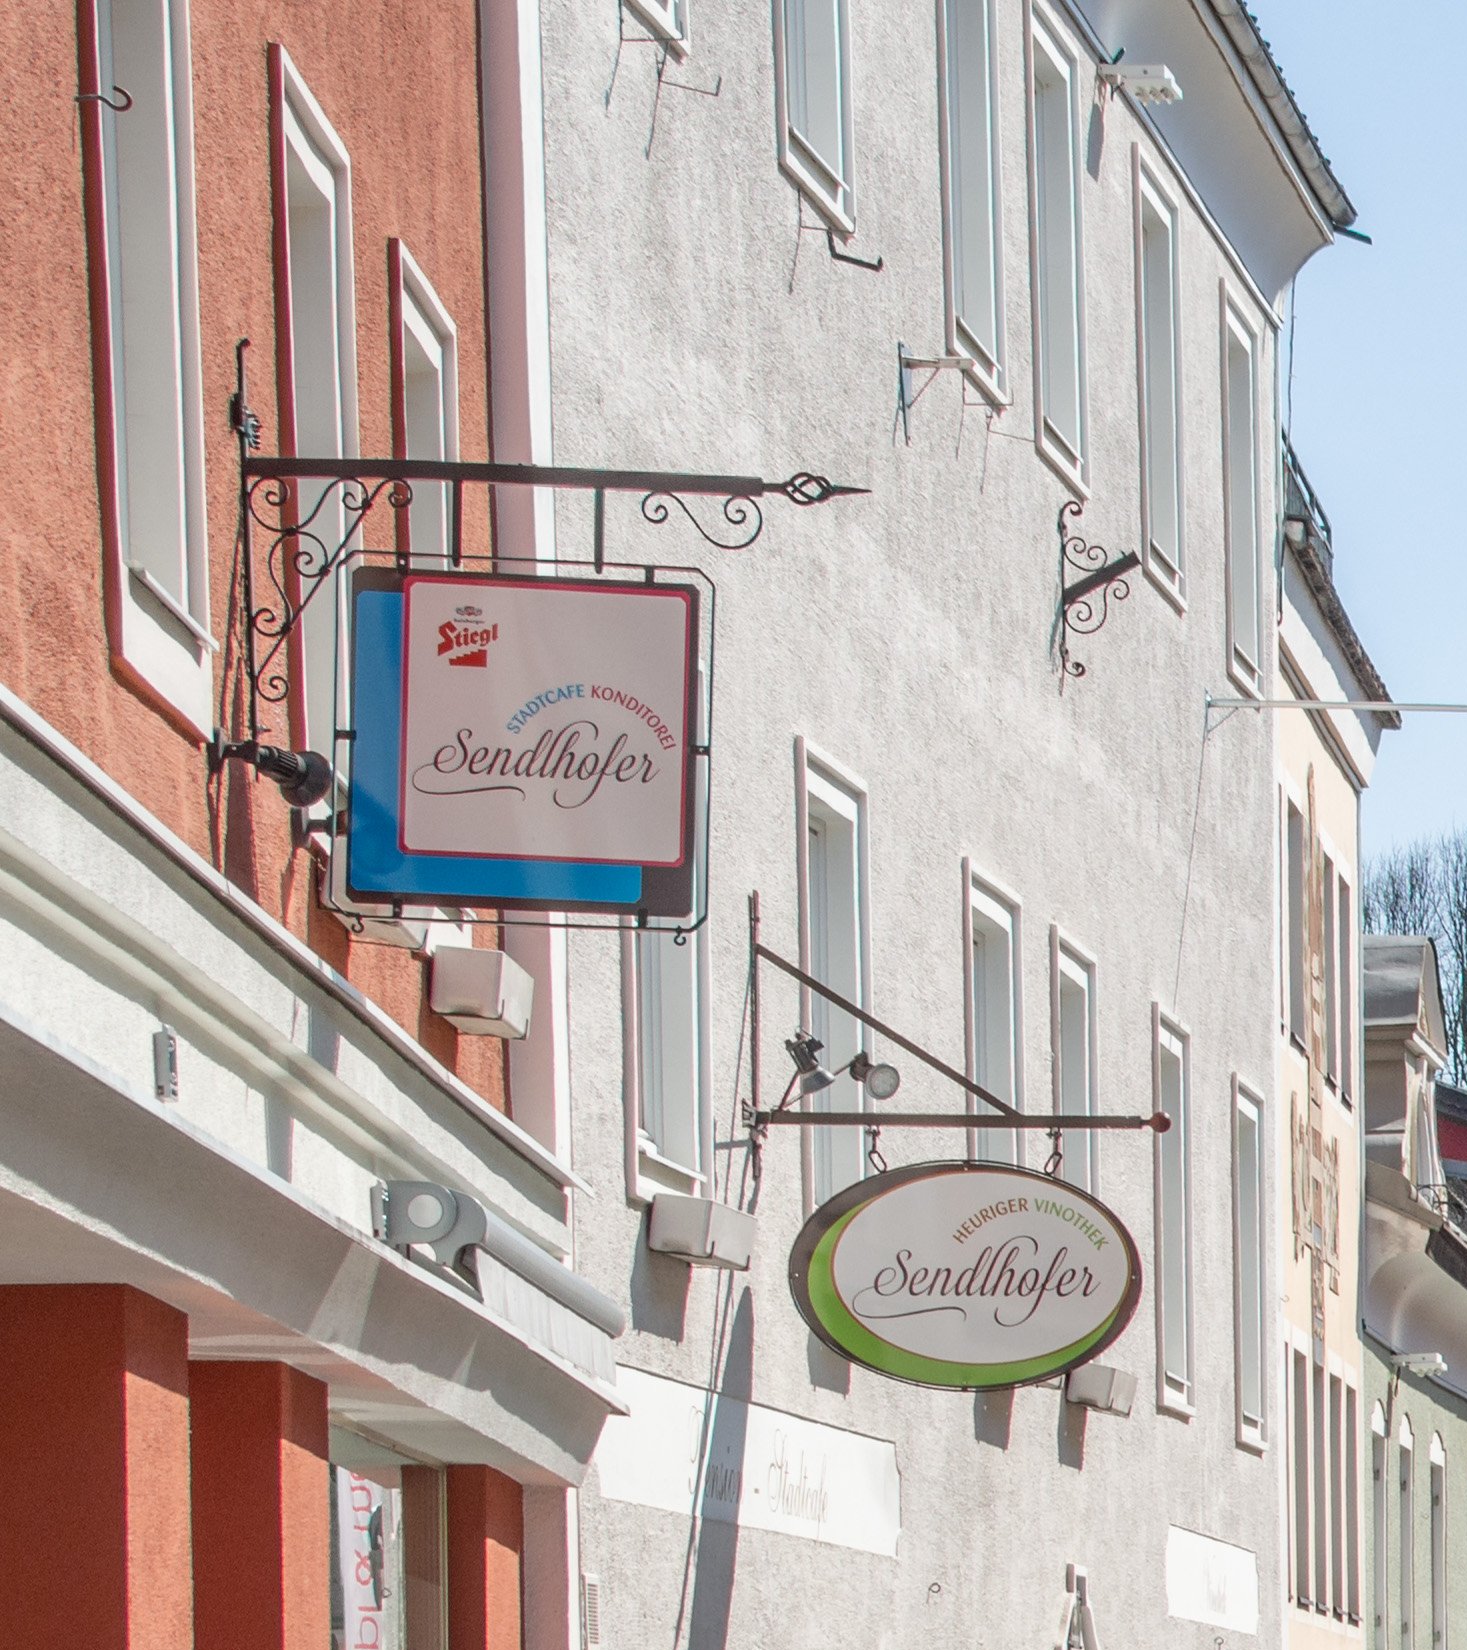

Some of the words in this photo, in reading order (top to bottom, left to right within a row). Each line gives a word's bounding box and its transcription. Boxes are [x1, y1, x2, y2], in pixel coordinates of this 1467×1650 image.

[437, 621, 499, 656] Stiegl
[506, 683, 585, 735] STADTCAFE
[590, 684, 677, 751] KONDITOREI
[411, 720, 661, 809] Sendlhofer
[952, 1197, 1029, 1245] HEURIGER
[1033, 1197, 1110, 1251] VINOTHEK
[852, 1235, 1101, 1327] Sendlhofer
